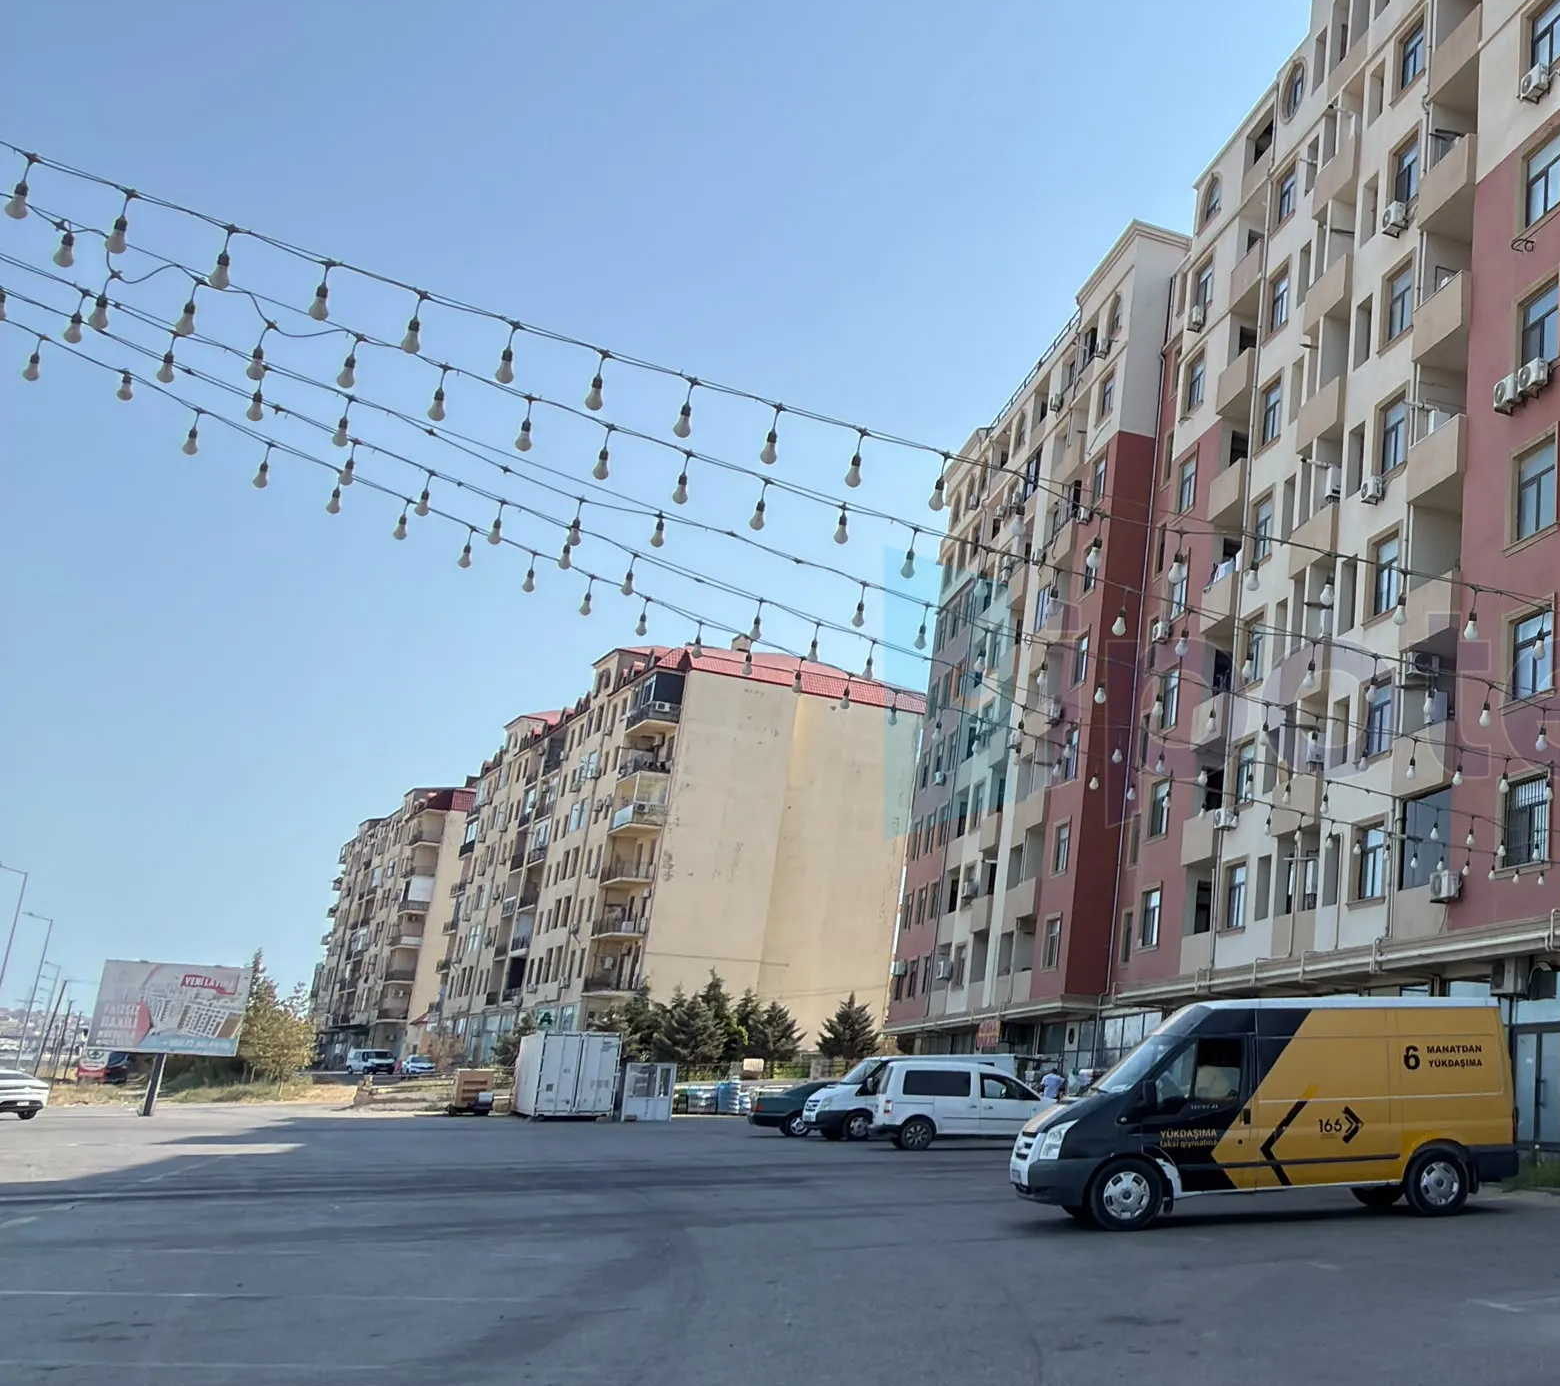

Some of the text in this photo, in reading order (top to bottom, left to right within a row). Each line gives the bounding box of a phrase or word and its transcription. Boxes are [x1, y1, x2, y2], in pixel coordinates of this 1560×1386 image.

[1426, 1044, 1483, 1054] MANATDAN
[1403, 1045, 1421, 1071] 6
[1318, 1117, 1343, 1134] 166
